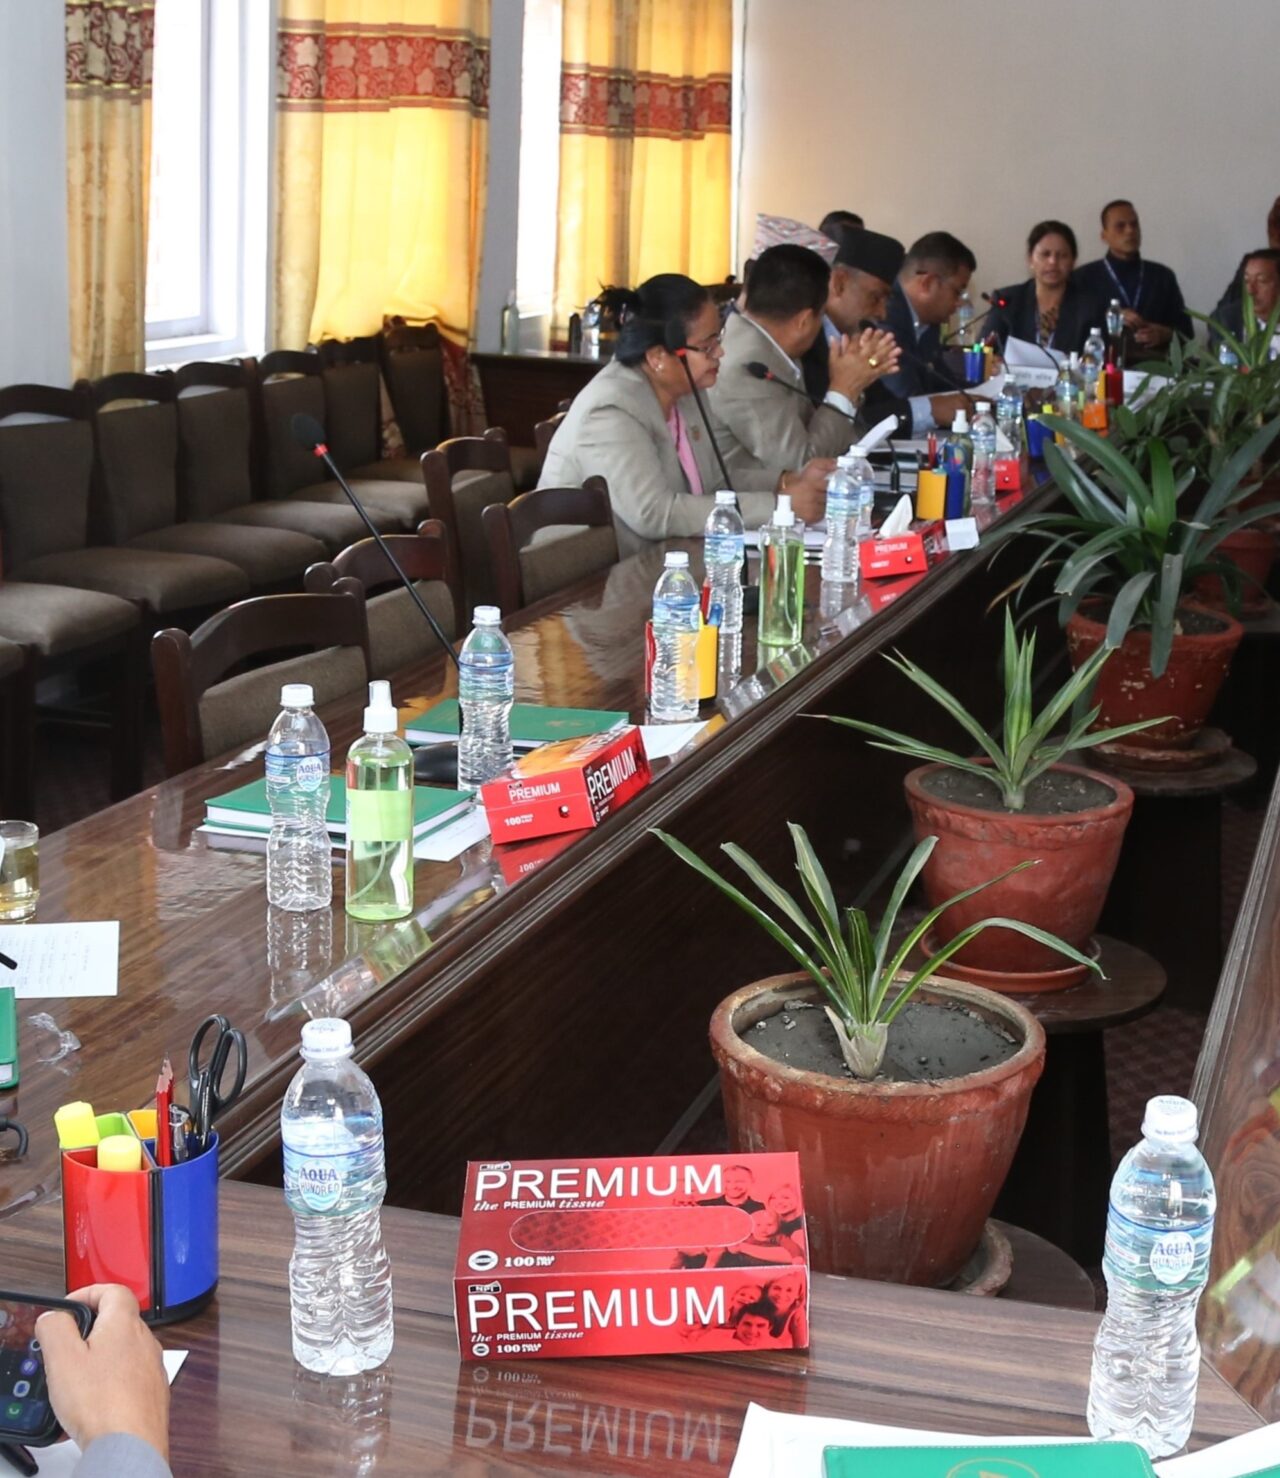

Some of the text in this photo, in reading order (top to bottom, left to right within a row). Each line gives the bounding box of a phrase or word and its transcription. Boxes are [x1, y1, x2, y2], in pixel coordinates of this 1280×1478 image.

[587, 746, 637, 804] PREMIUM
[509, 782, 561, 802] PREMIUM
[504, 815, 521, 826] 100
[300, 1167, 338, 1181] AQUA
[301, 1181, 340, 1195] HUNDRED
[475, 1164, 722, 1201] PREMIUM
[473, 1198, 605, 1212] the PREMIUM tissue
[1153, 1241, 1193, 1256] AQUA
[504, 1256, 535, 1268] 100
[468, 1286, 728, 1333] PREMIUM
[470, 1330, 584, 1343] the PREMIUM tissue
[496, 1344, 521, 1354] 100
